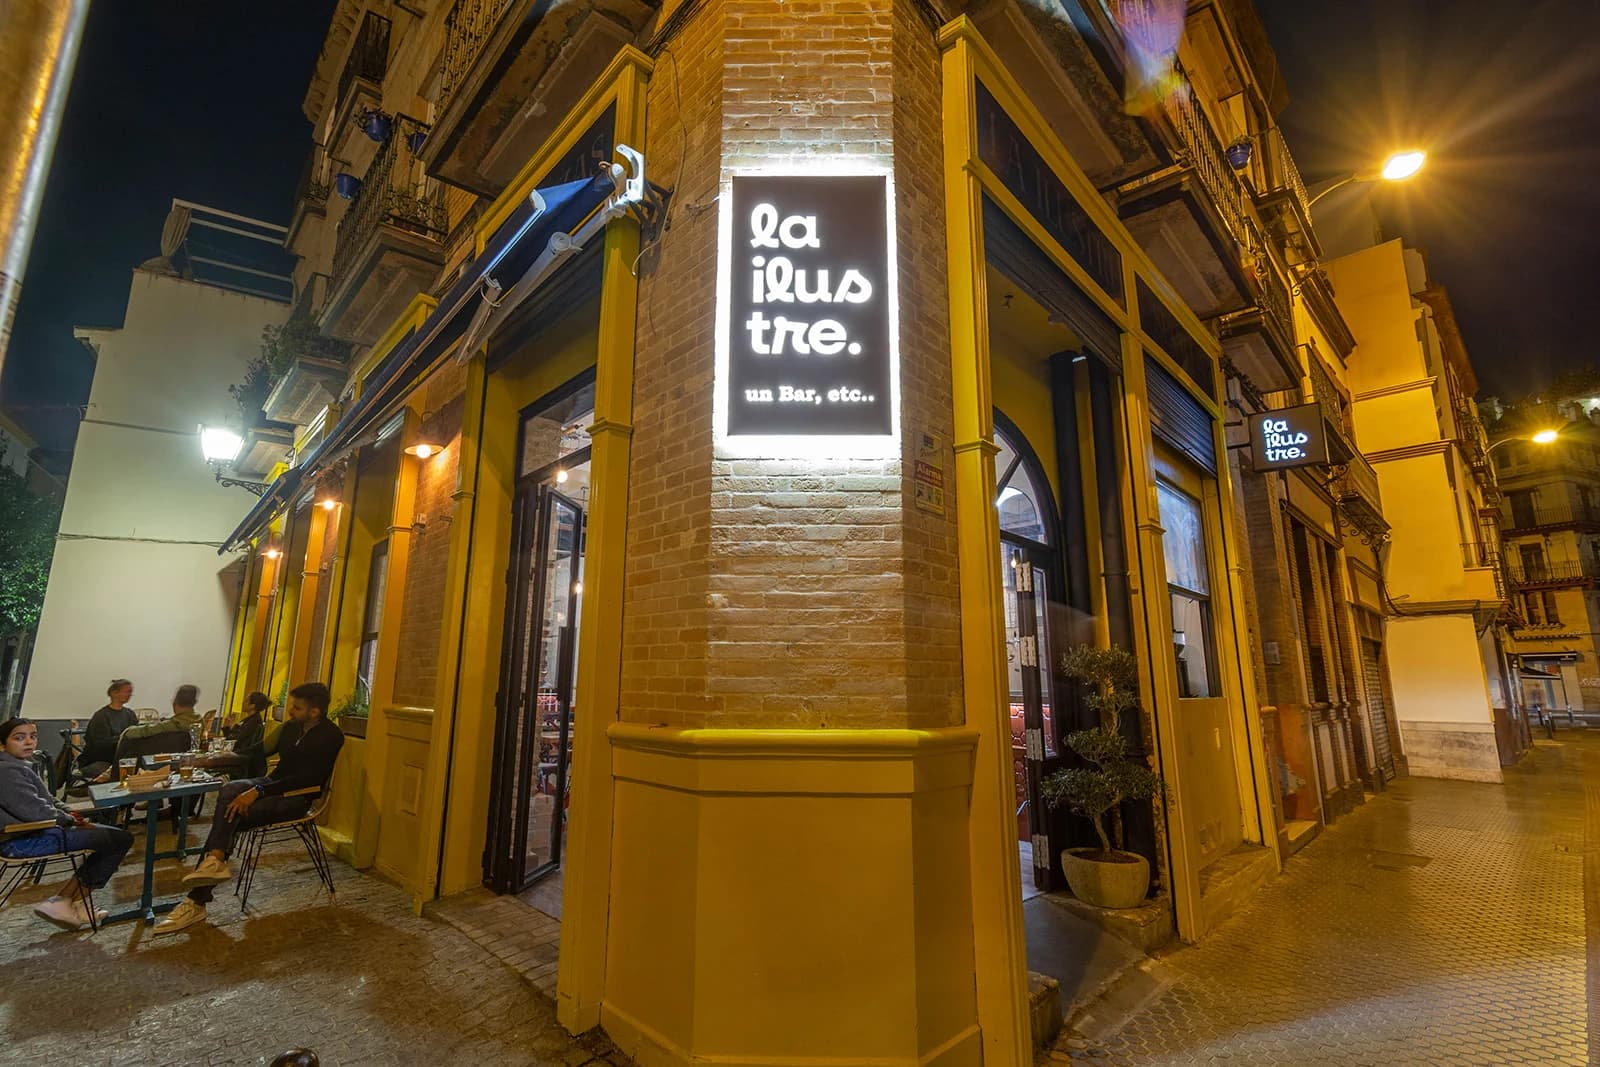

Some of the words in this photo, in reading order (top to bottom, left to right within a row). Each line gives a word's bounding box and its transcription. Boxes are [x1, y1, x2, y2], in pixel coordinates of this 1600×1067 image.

[750, 203, 820, 249] la
[752, 255, 873, 304] ilus
[746, 311, 862, 356] tre.
[744, 388, 774, 402] un
[778, 385, 822, 406] Bar,
[1263, 419, 1288, 434] la
[1264, 432, 1308, 449] ilus
[1265, 446, 1306, 461] tre.
